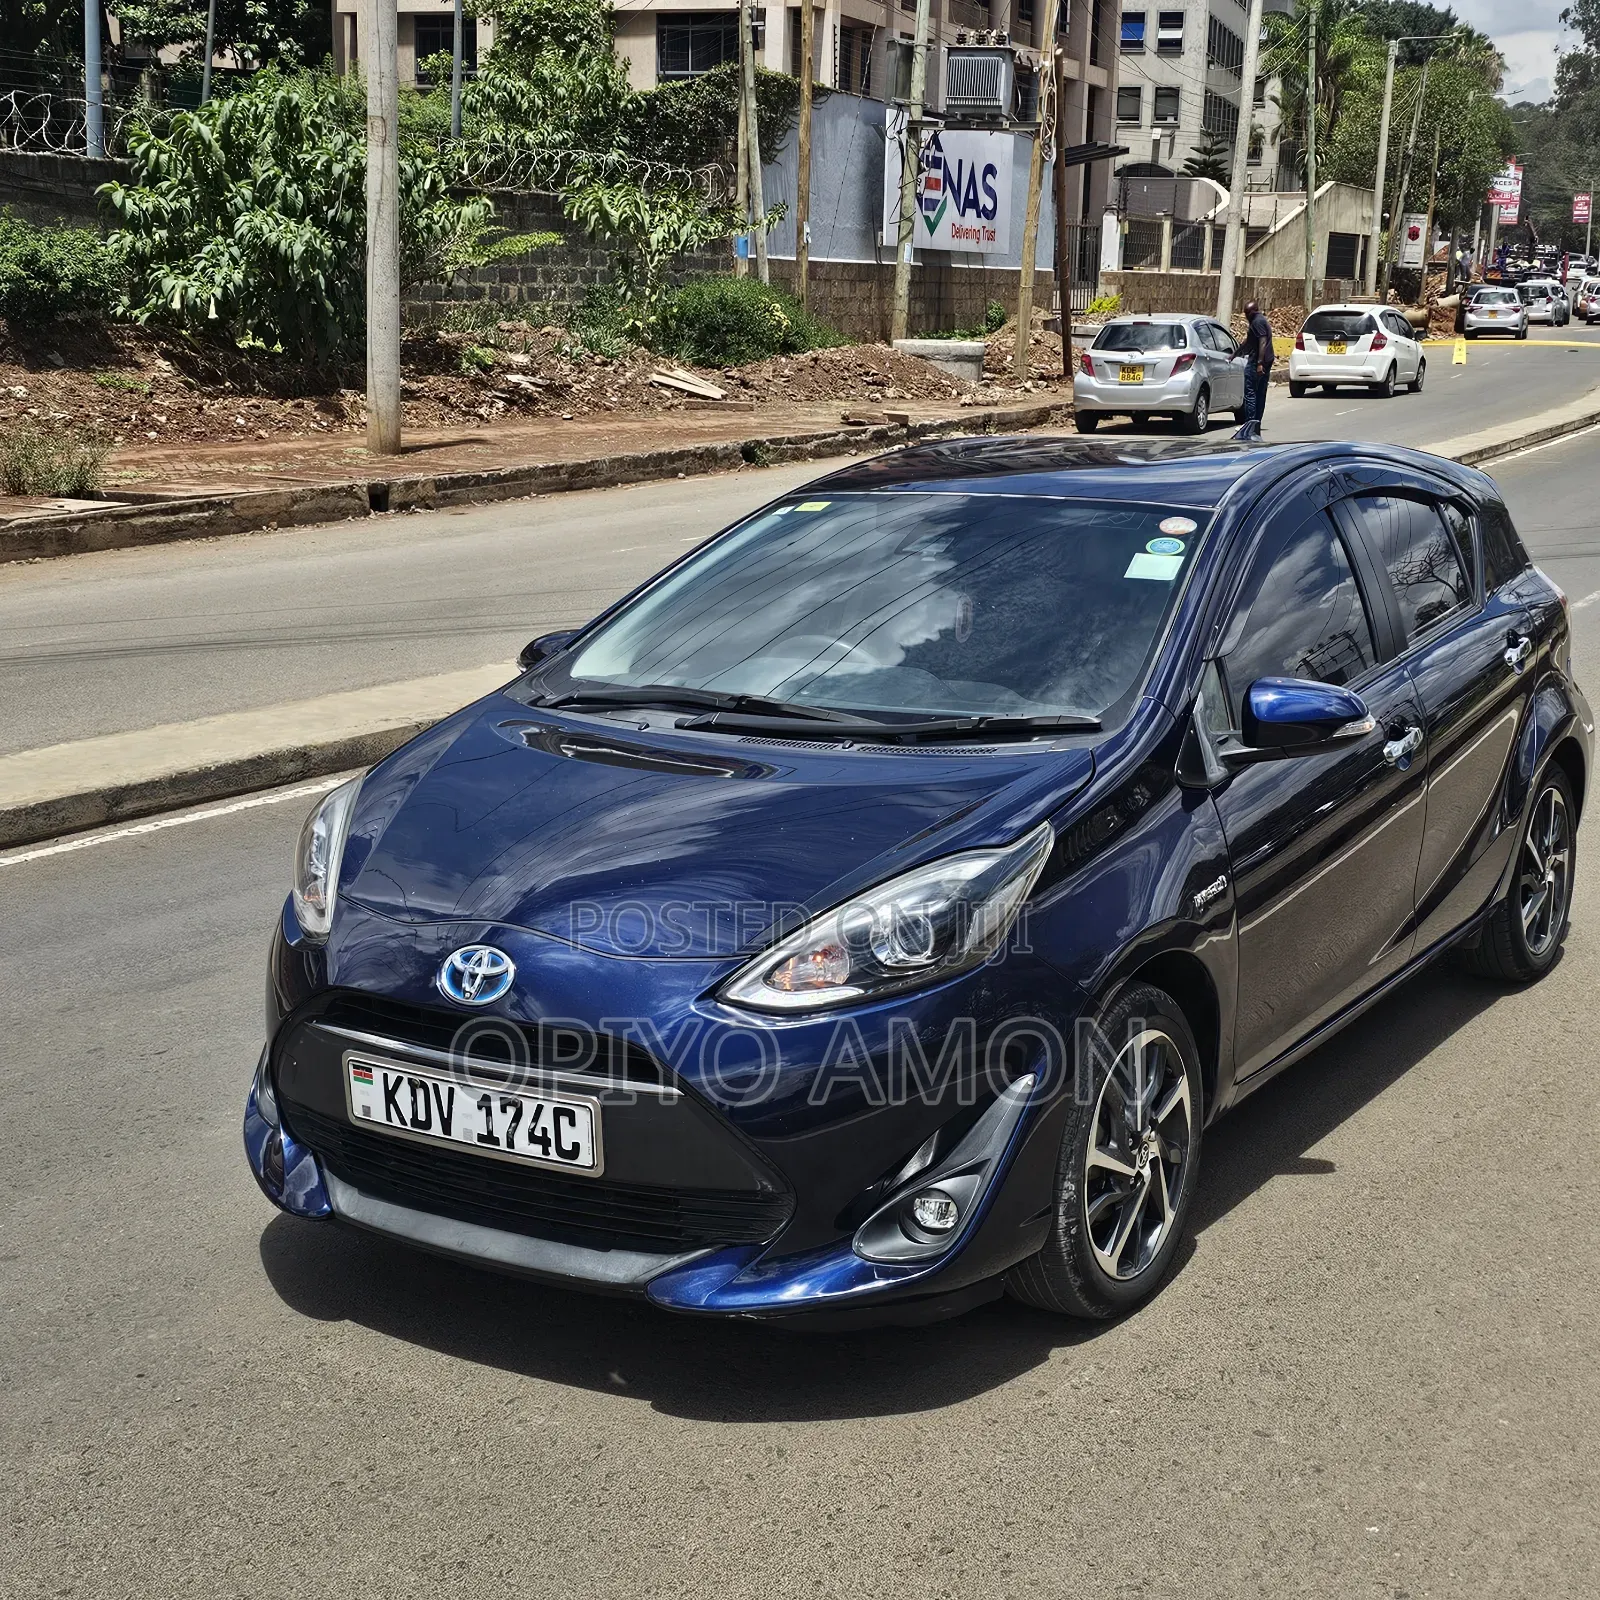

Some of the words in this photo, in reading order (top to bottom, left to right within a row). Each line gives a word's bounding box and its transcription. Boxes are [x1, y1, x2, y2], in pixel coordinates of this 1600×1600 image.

[951, 222, 981, 244] Delivering
[981, 225, 996, 242] Trust
[1121, 366, 1137, 374] KDE
[1121, 373, 1141, 381] 884G
[382, 1071, 455, 1137] KDV
[476, 1092, 581, 1161] 174C
